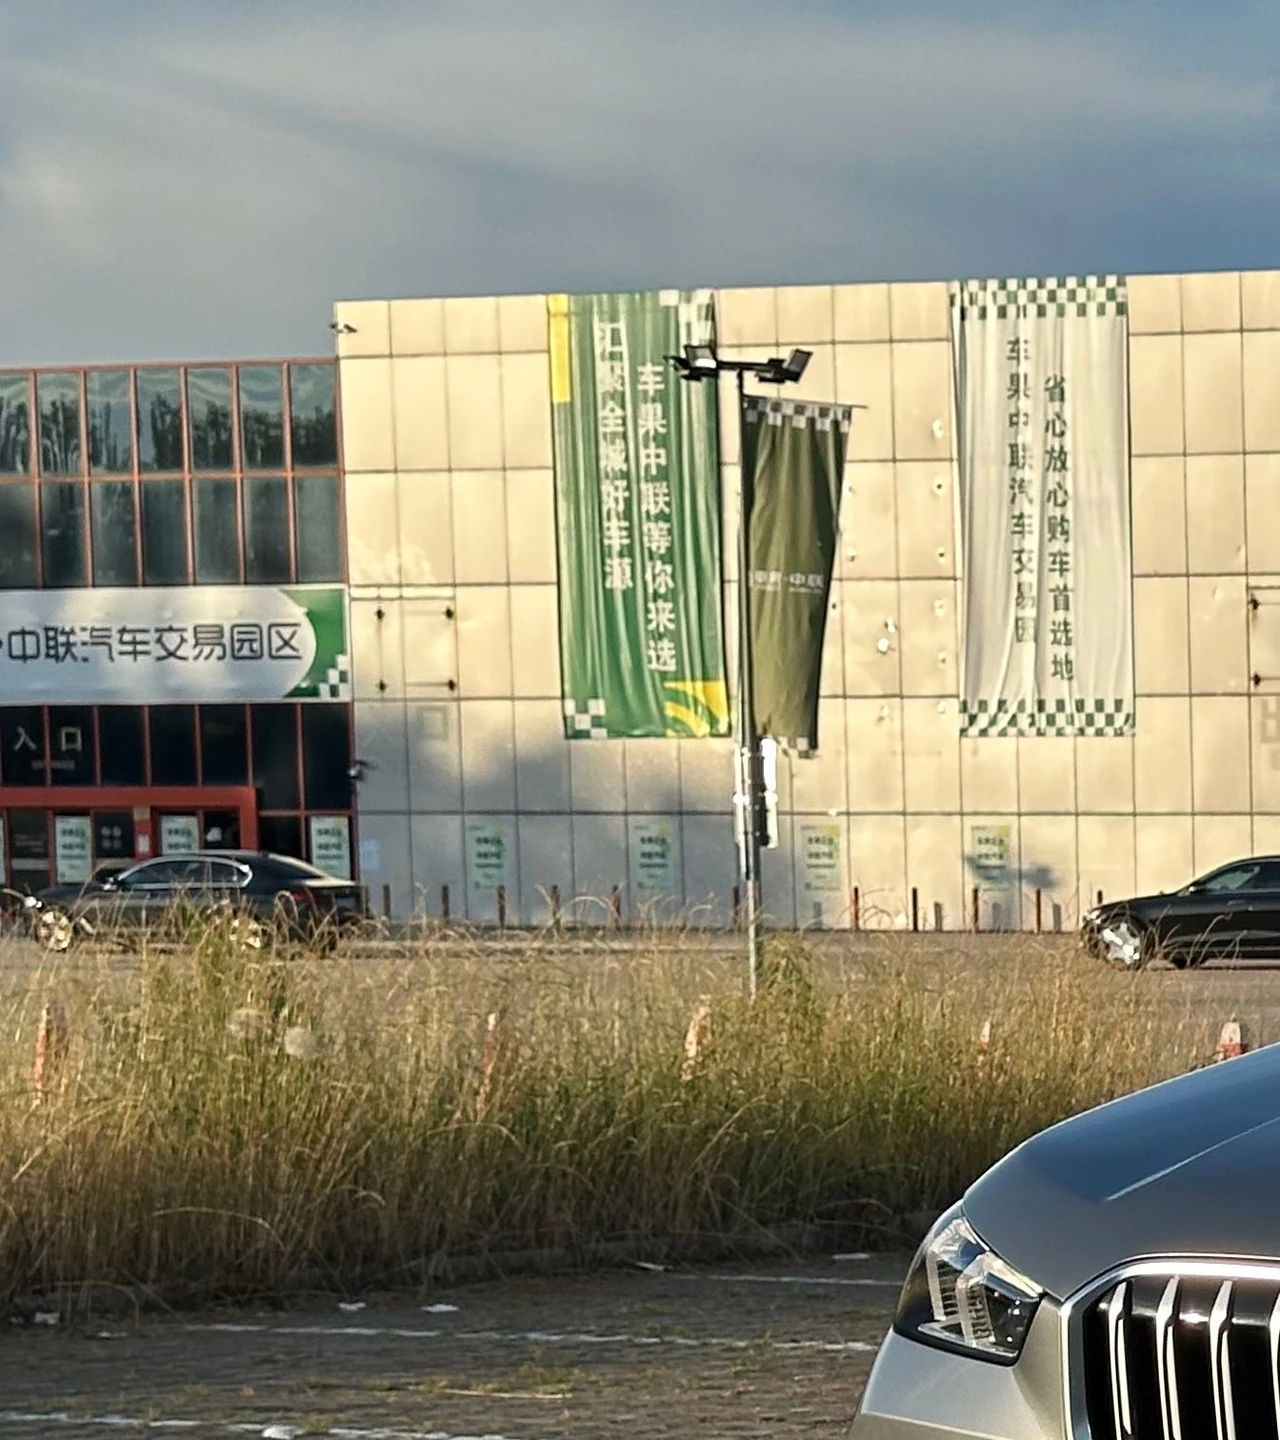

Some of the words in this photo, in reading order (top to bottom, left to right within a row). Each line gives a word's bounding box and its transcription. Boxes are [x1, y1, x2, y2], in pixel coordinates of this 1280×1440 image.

[637, 362, 677, 672] 车果中联等你来选
[1044, 373, 1074, 682] 省心放心购车首选地
[14, 726, 83, 751] 入口
